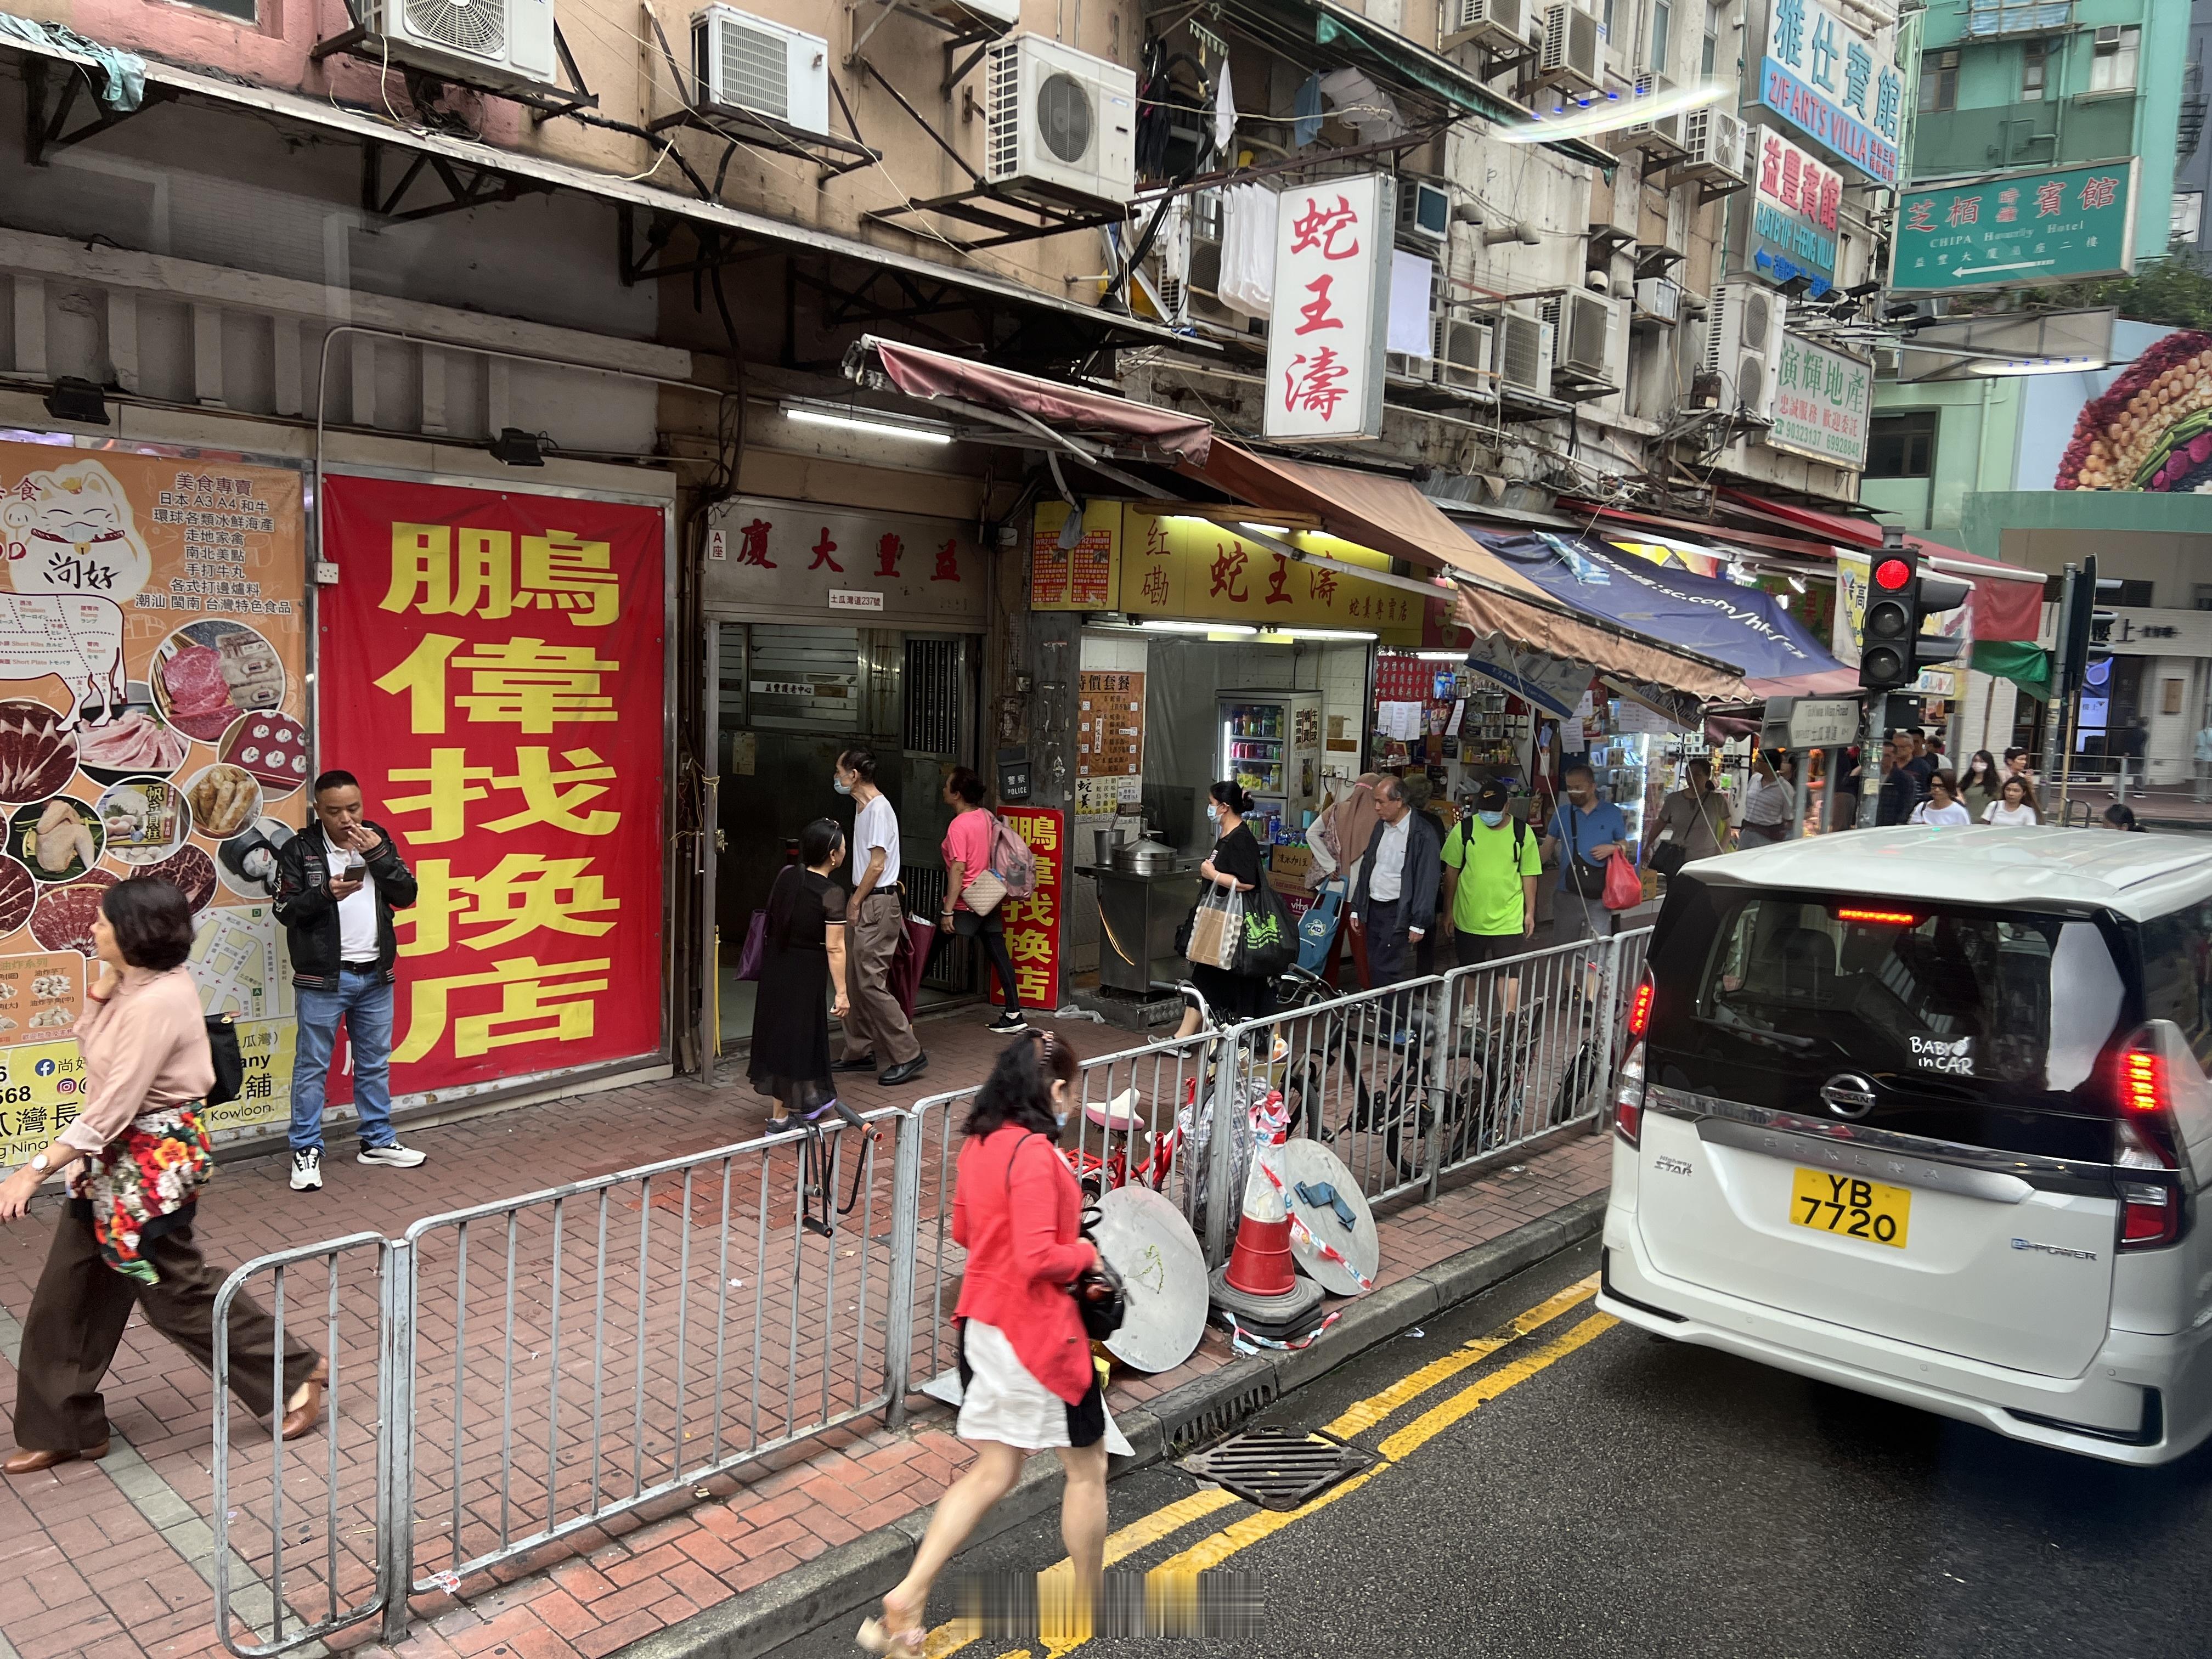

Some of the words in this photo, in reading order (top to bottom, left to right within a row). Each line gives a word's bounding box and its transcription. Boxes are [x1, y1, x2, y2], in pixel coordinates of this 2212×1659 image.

[1774, 0, 1900, 142] 雅仕賓館
[1769, 72, 1792, 112] 2/F
[1790, 84, 1828, 138] ARTS
[1831, 112, 1867, 166] VILLA
[1760, 136, 1842, 233] 益豐賓館
[1929, 235, 1972, 248] CHIPA
[2047, 220, 2084, 234] Hotel
[1285, 194, 1359, 422] 蛇王濤
[1779, 339, 1865, 414] 演輝地產
[177, 473, 253, 497] 美食專賣
[160, 493, 189, 507] 日本
[193, 495, 213, 507] A3
[217, 498, 236, 509] A4
[241, 499, 268, 514] 和牛
[154, 509, 274, 532] 環球各類冰鮮海產
[185, 529, 245, 545] 走地家禽
[185, 546, 245, 563] 南北美點
[43, 552, 122, 589] 尚好
[185, 563, 245, 579] 手打牛丸
[1210, 540, 1339, 607] 蛇王濤
[171, 579, 261, 596] 各式打邊爐料
[1007, 774, 1026, 785] 警察
[1007, 786, 1028, 795] POLICE
[373, 521, 621, 1064] 鵬偉找換店
[145, 786, 164, 840] 帆立貝柱
[1909, 1036, 1957, 1057] BABY
[1918, 1057, 1933, 1067] in
[1936, 1056, 1974, 1075] CAR
[1825, 1090, 1876, 1104] NISSAN
[211, 1103, 275, 1121] Kowloon.
[1654, 1160, 1692, 1177] STAR
[1763, 1136, 1940, 1181] SERENA
[1828, 1173, 1872, 1209] YB
[1800, 1196, 1897, 1242] 7720
